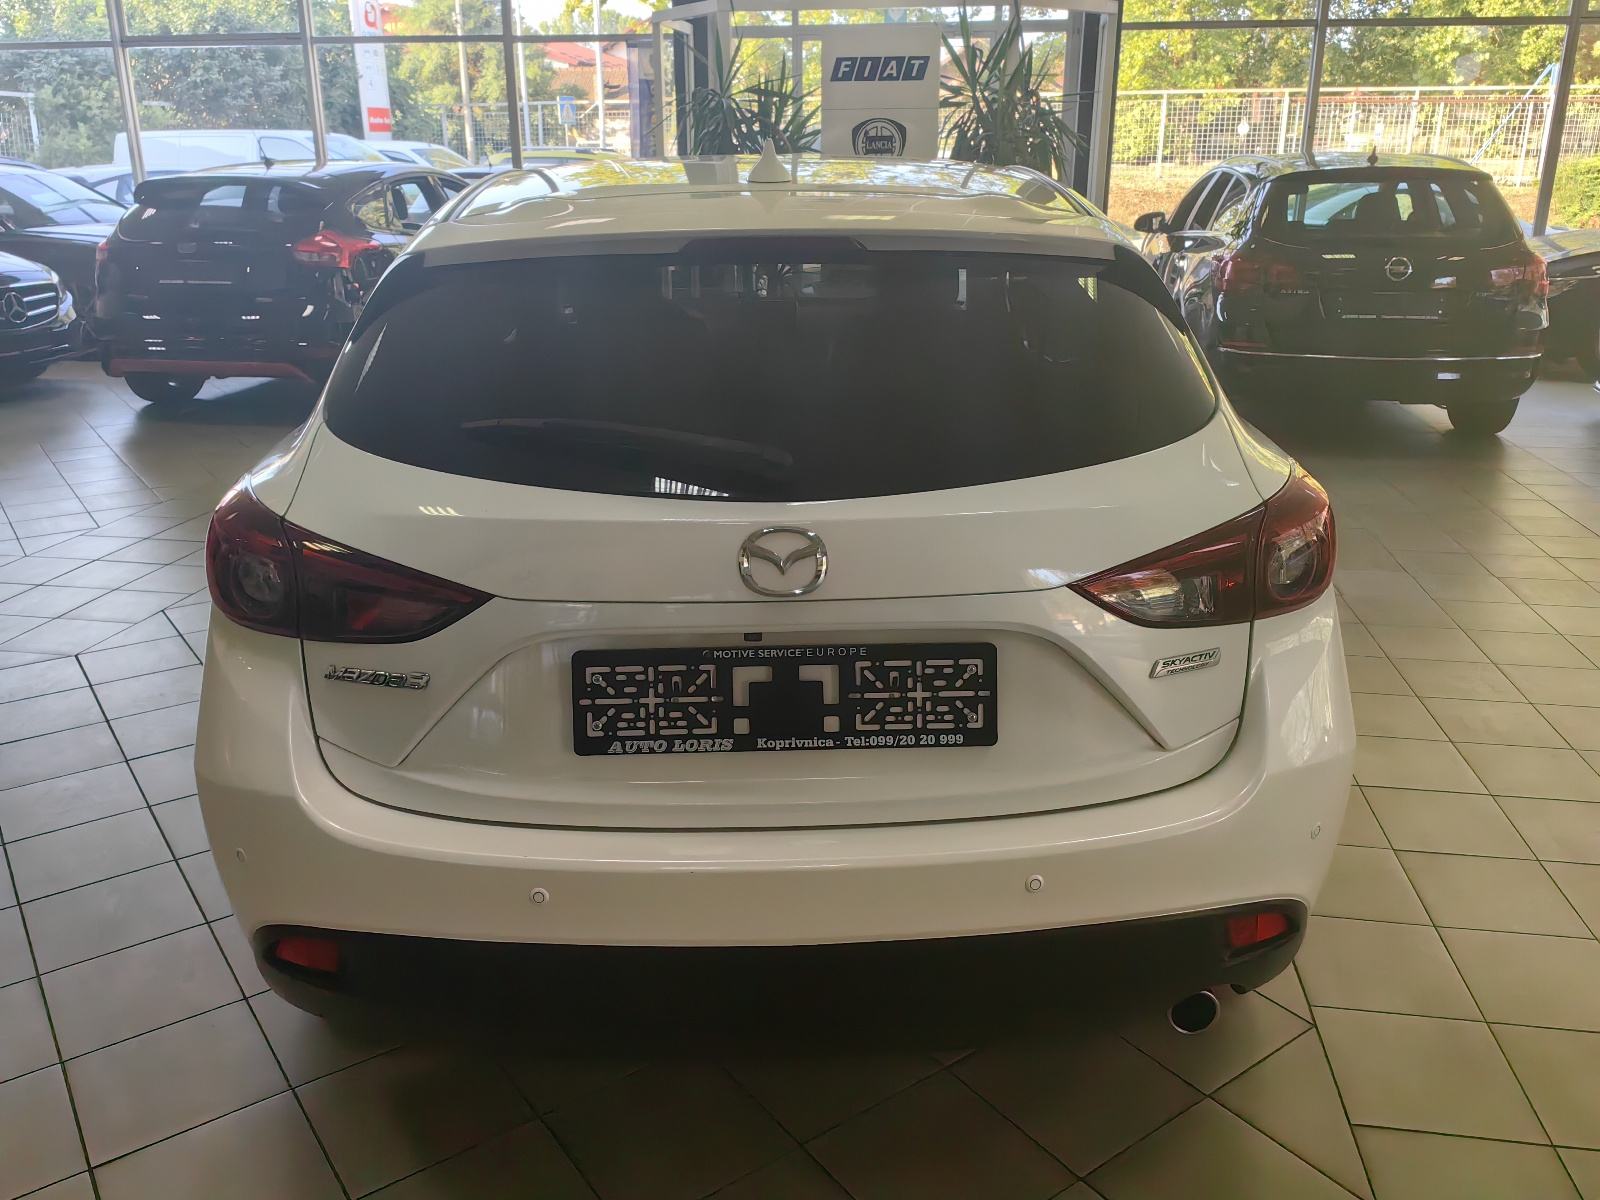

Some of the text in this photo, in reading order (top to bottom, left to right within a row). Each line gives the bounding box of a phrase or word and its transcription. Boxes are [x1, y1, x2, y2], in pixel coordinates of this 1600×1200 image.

[835, 58, 926, 79] FIAT
[865, 140, 893, 151] LANCIA
[758, 648, 801, 658] SERVICE
[806, 647, 868, 657] EUROPE
[1161, 651, 1216, 668] SKYACTIV
[607, 738, 734, 754] AUTO LORIS
[919, 734, 936, 745] 20
[939, 733, 964, 745] 999
